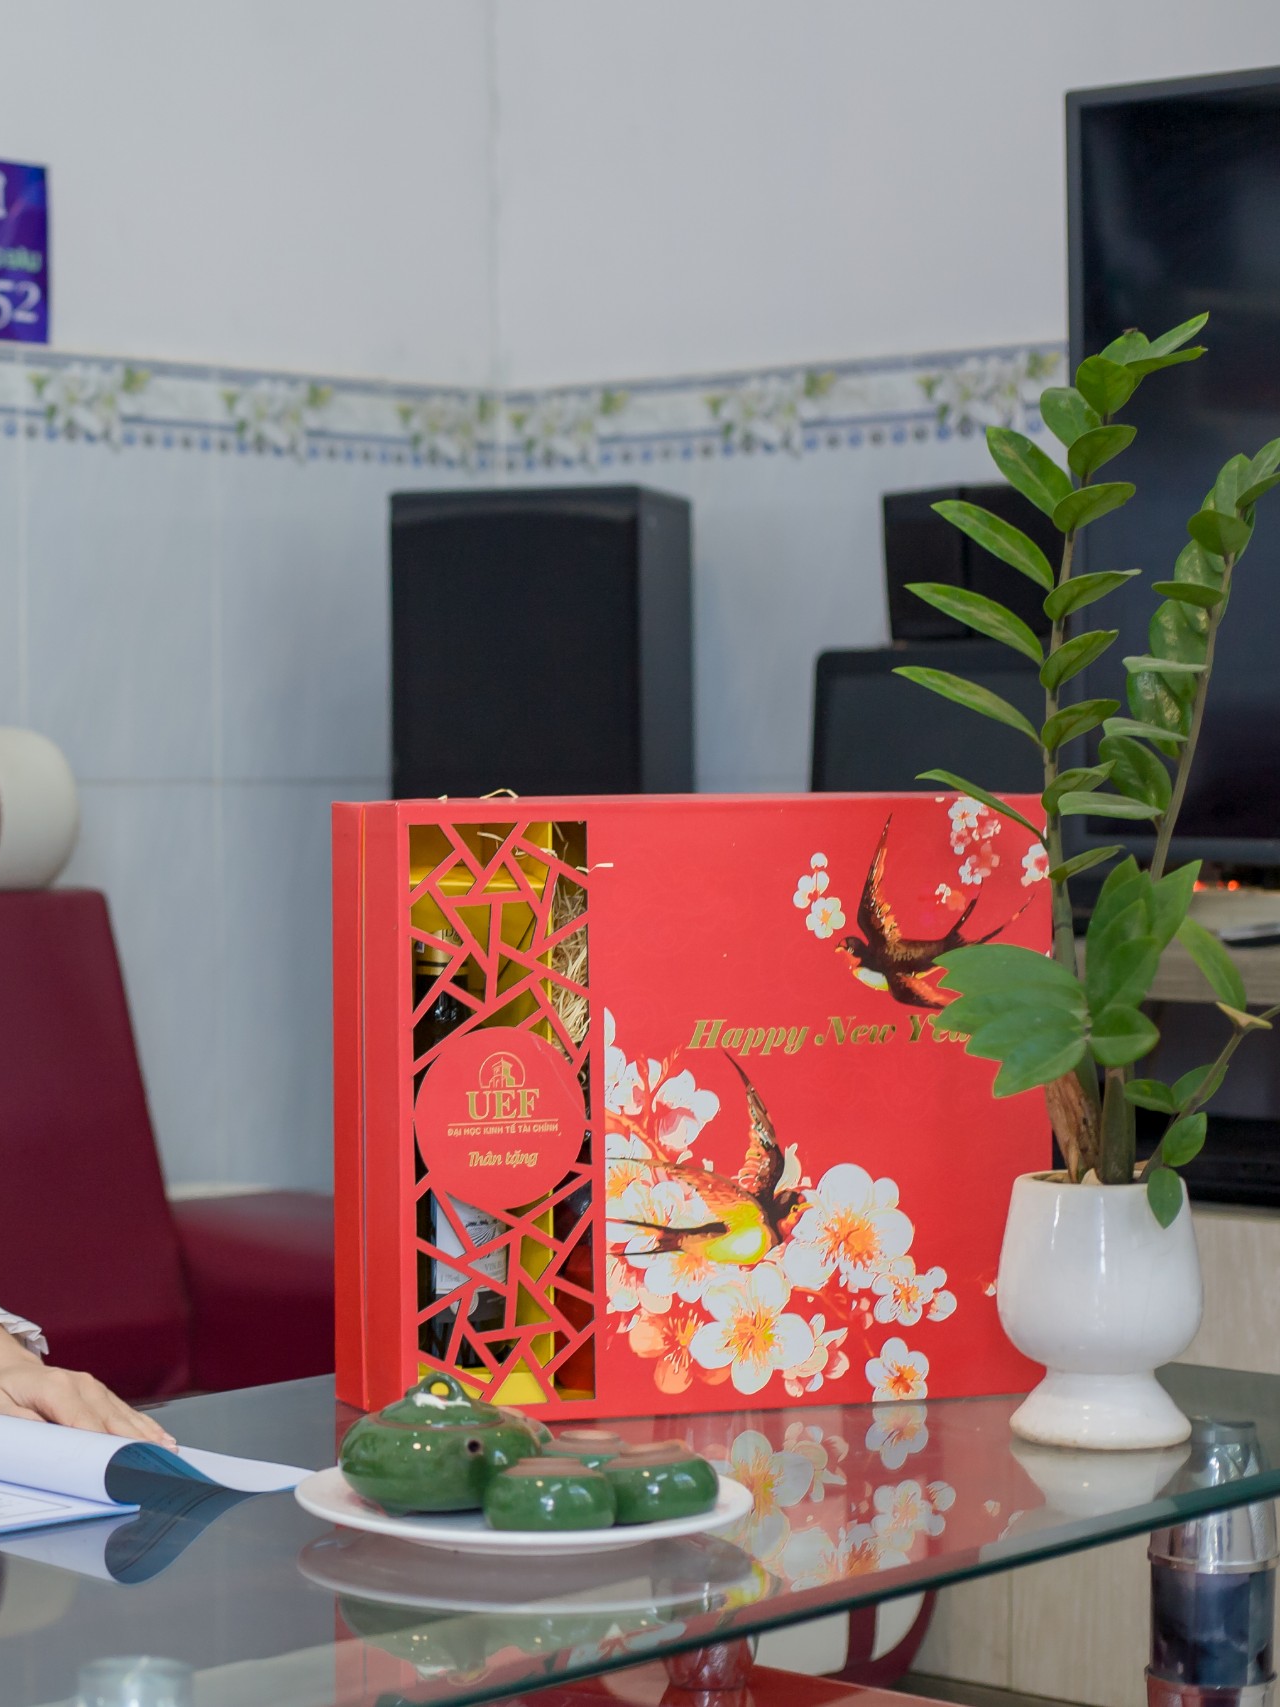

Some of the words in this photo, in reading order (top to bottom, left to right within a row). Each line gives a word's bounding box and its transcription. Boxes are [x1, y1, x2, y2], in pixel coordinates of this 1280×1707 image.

[685, 1019, 809, 1056] Happy
[814, 1016, 896, 1046] New
[907, 1013, 972, 1043] Yea
[466, 1088, 540, 1120] UEF
[447, 1128, 462, 1138] ĐẠI
[463, 1127, 481, 1137] HỌC
[483, 1126, 503, 1135] KINH
[505, 1122, 516, 1134] TẾ
[518, 1124, 531, 1133] TÀI
[532, 1122, 559, 1133] CHÍNH
[468, 1150, 503, 1167] Thân
[505, 1149, 538, 1169] tặng
